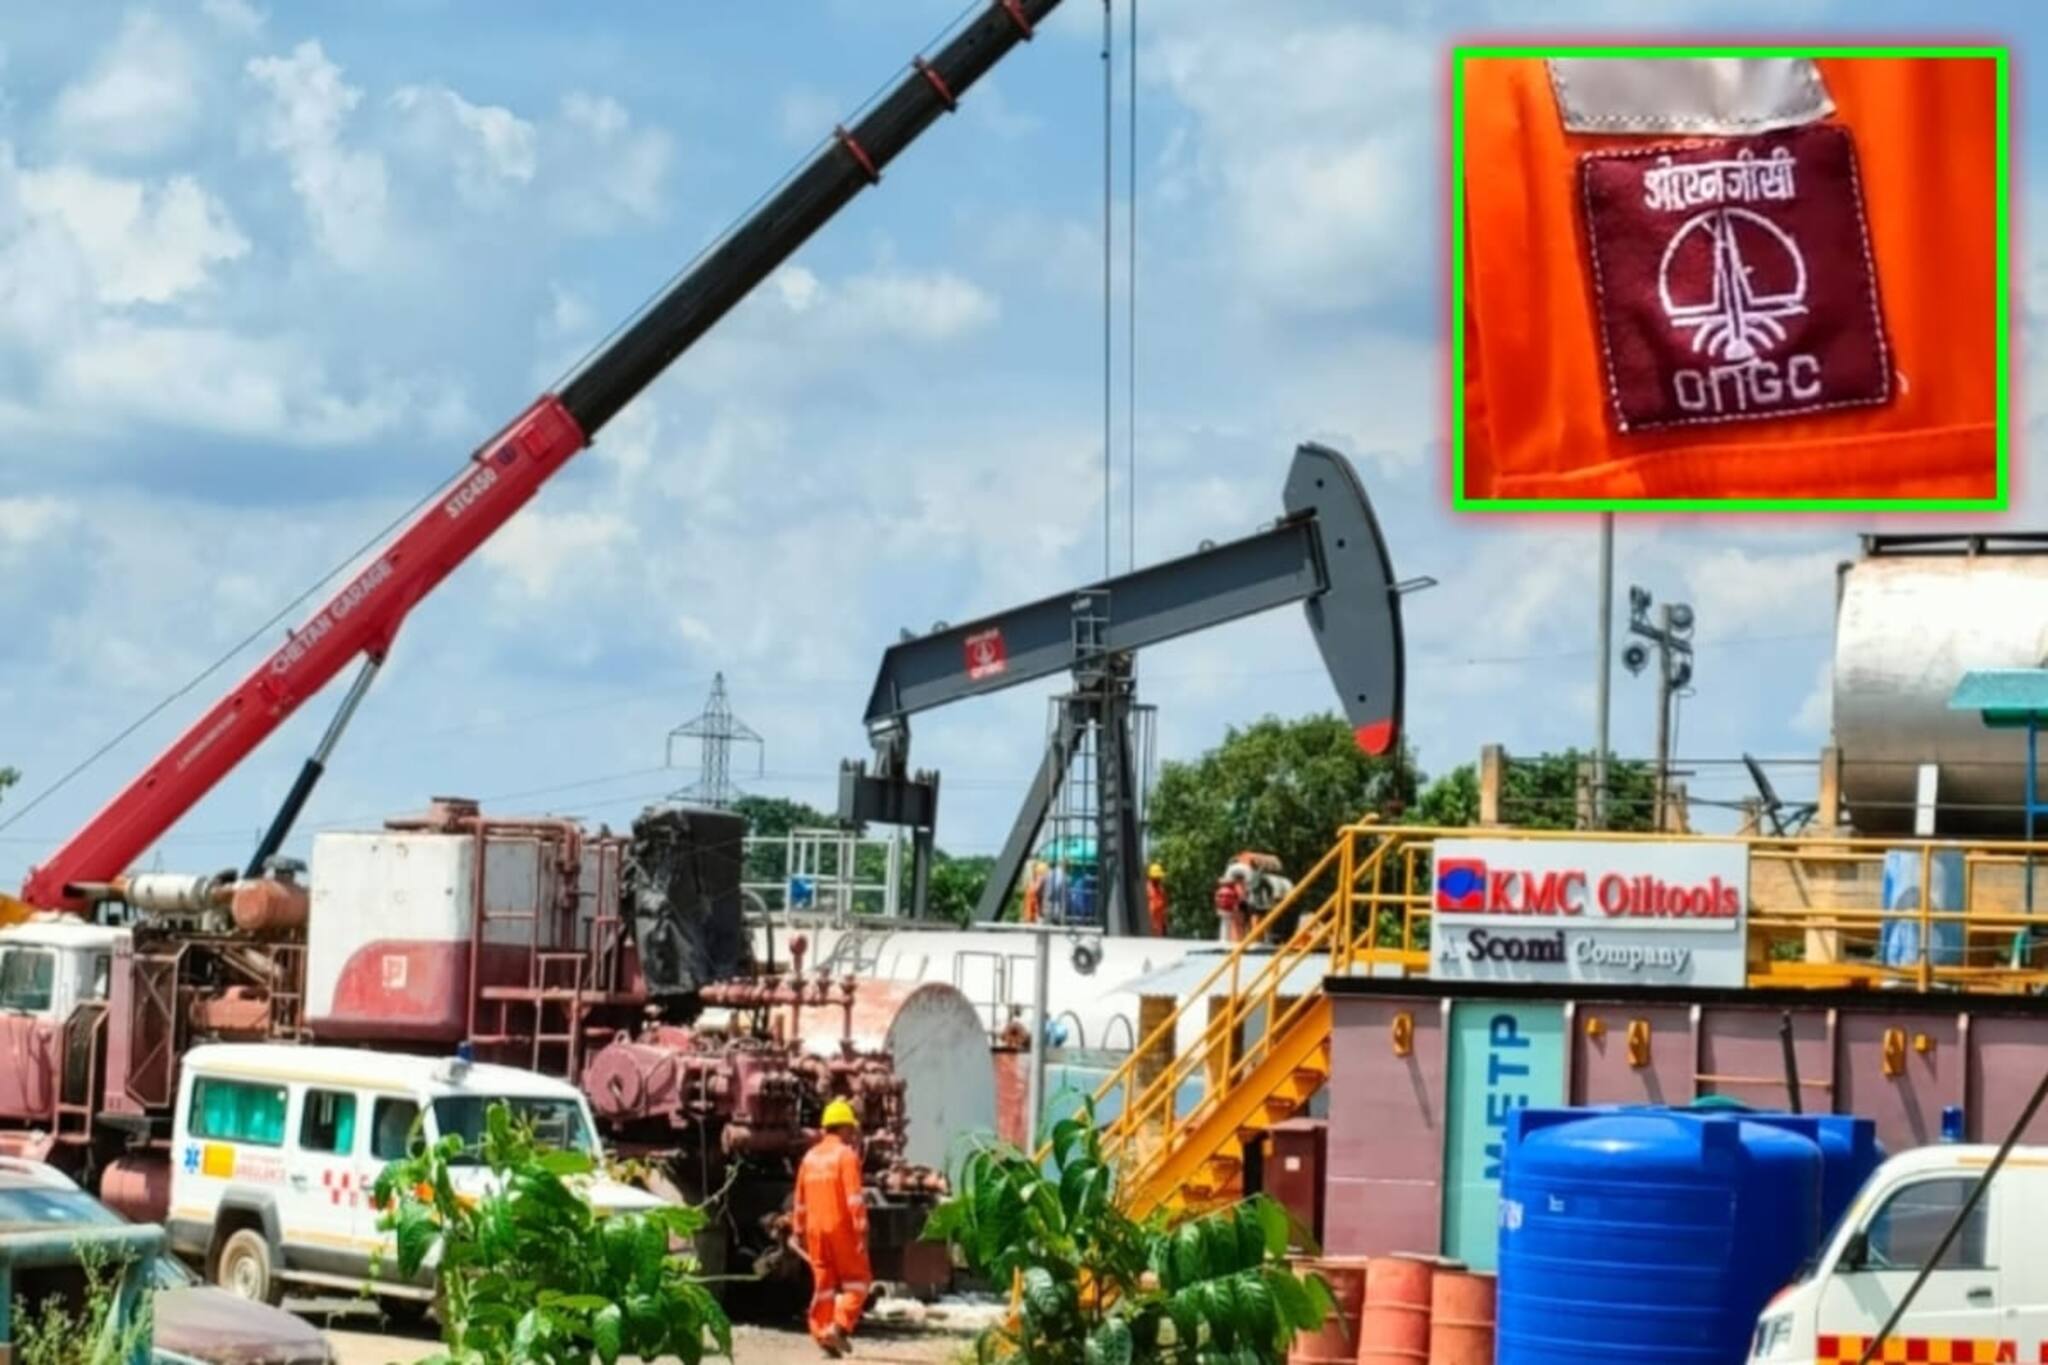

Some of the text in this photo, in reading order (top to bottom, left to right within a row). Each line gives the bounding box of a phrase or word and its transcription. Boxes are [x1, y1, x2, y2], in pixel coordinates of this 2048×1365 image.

[270, 557, 395, 674] CHETAN GARAGE
[1487, 871, 1740, 918] KMC Oiltools
[1467, 928, 1567, 963] Scomi
[1574, 937, 1692, 976] Company
